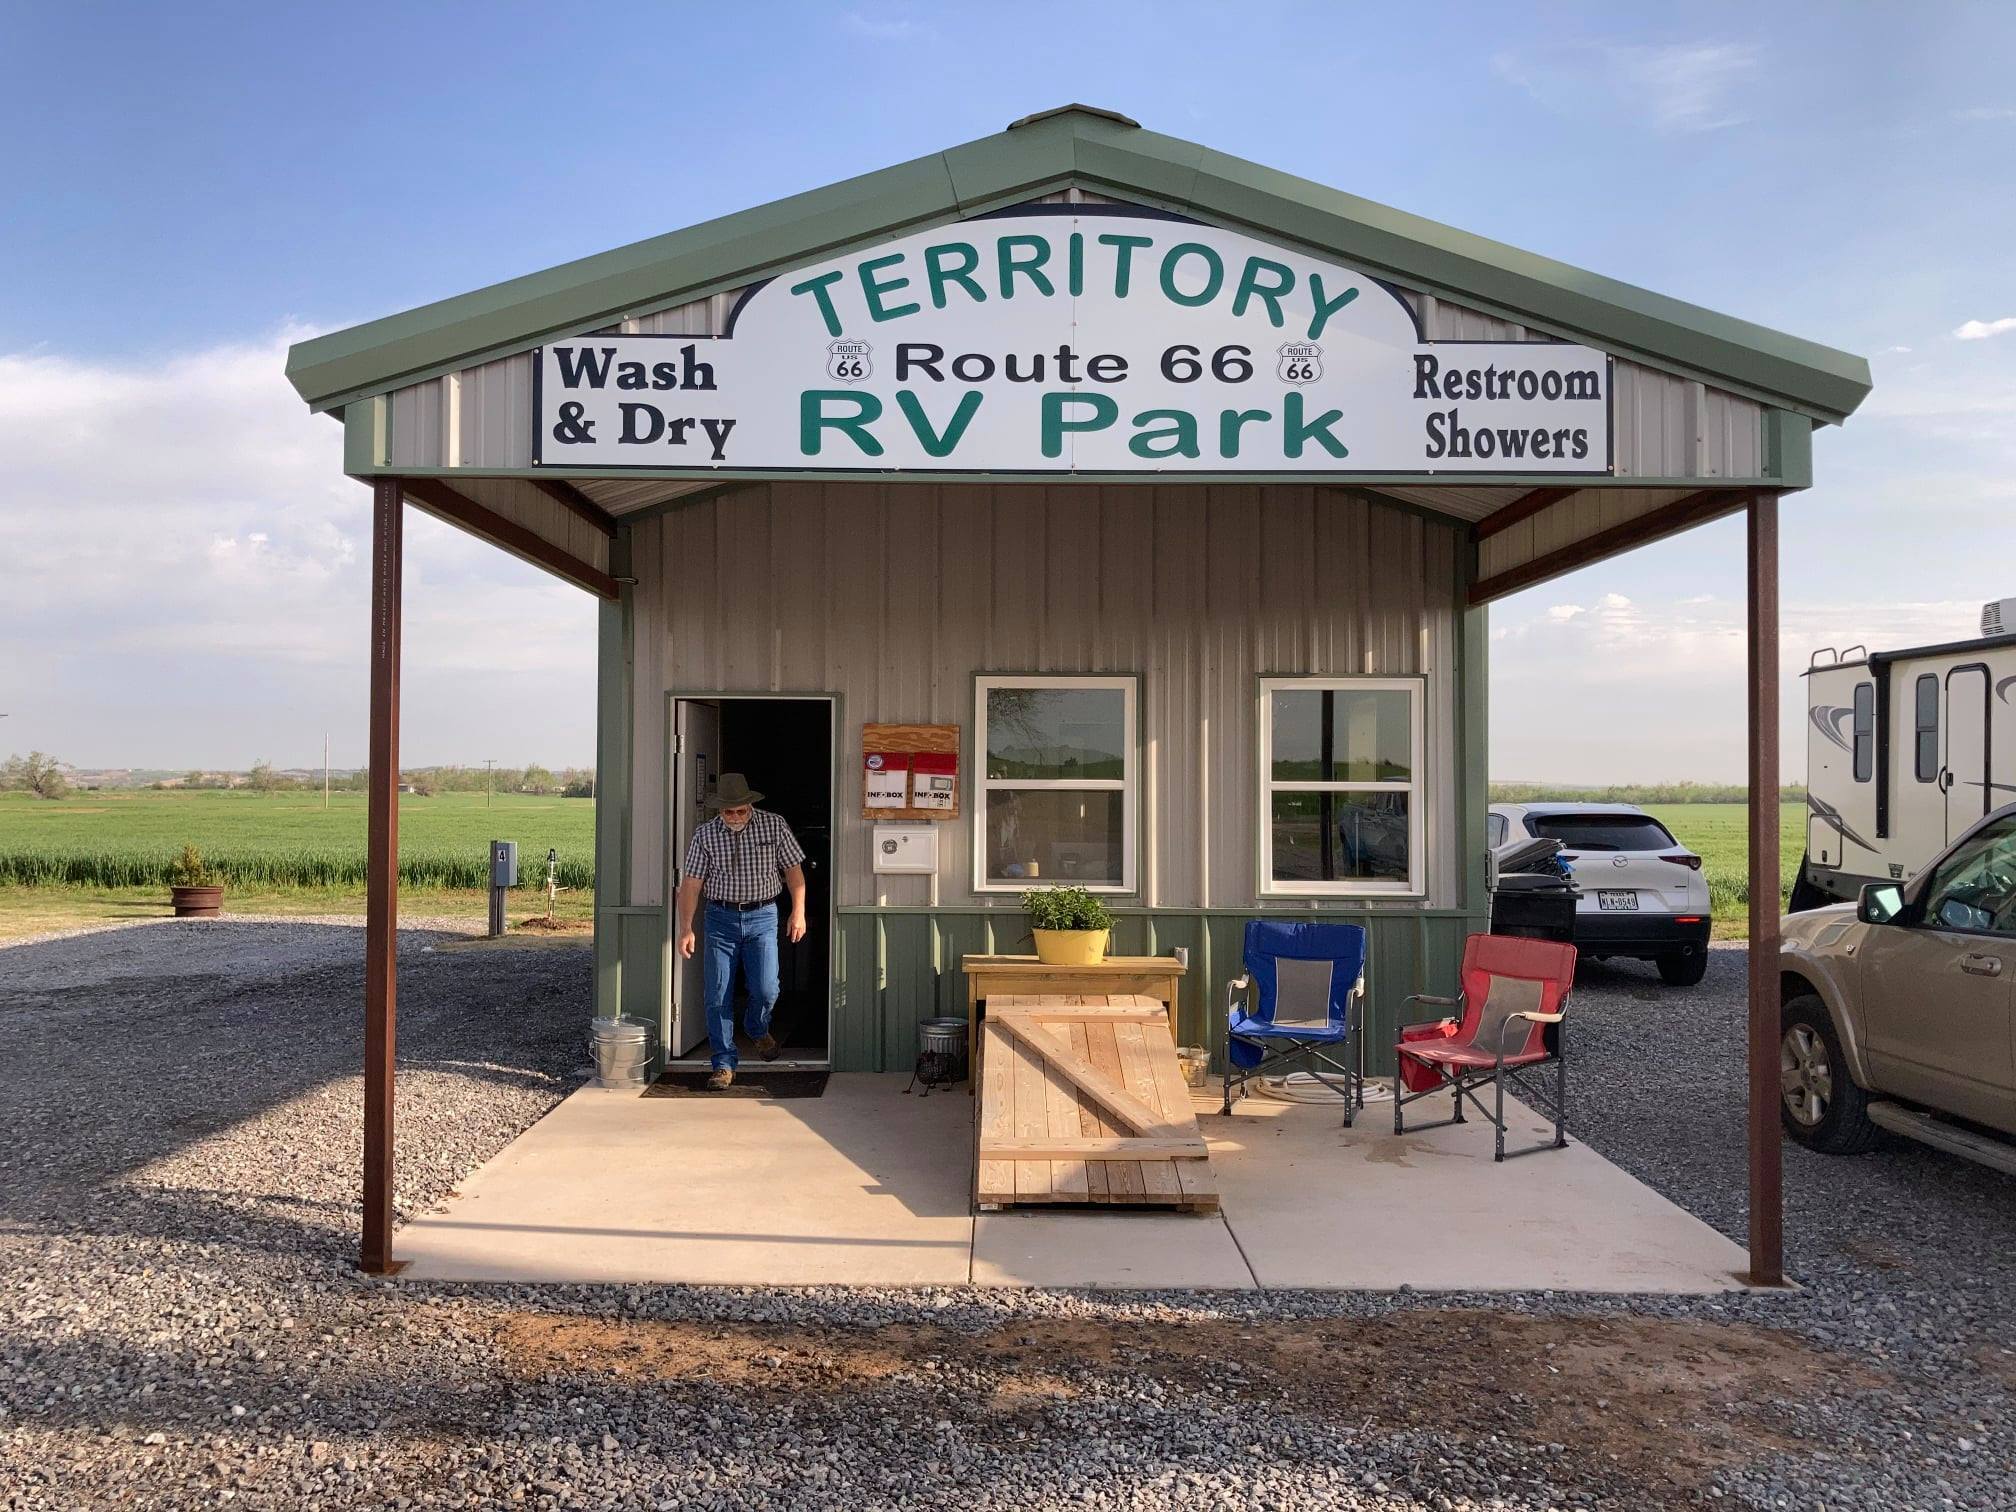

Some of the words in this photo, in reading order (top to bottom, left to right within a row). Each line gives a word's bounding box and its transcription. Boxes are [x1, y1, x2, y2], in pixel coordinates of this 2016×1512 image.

[790, 232, 1359, 341] TERRITORY
[553, 344, 717, 391] Wash
[837, 345, 863, 353] ROUTE
[837, 360, 863, 377] 66
[896, 343, 1129, 383] Route
[1160, 344, 1254, 384] 66
[1287, 347, 1313, 356] ROUTE
[1287, 363, 1313, 379] 66
[1413, 354, 1602, 401] Restroom
[552, 401, 597, 445] &
[617, 402, 737, 461] Dry
[800, 389, 984, 458] RV
[1040, 391, 1350, 459] Park
[1425, 408, 1589, 460] Showers
[499, 850, 505, 861] 4
